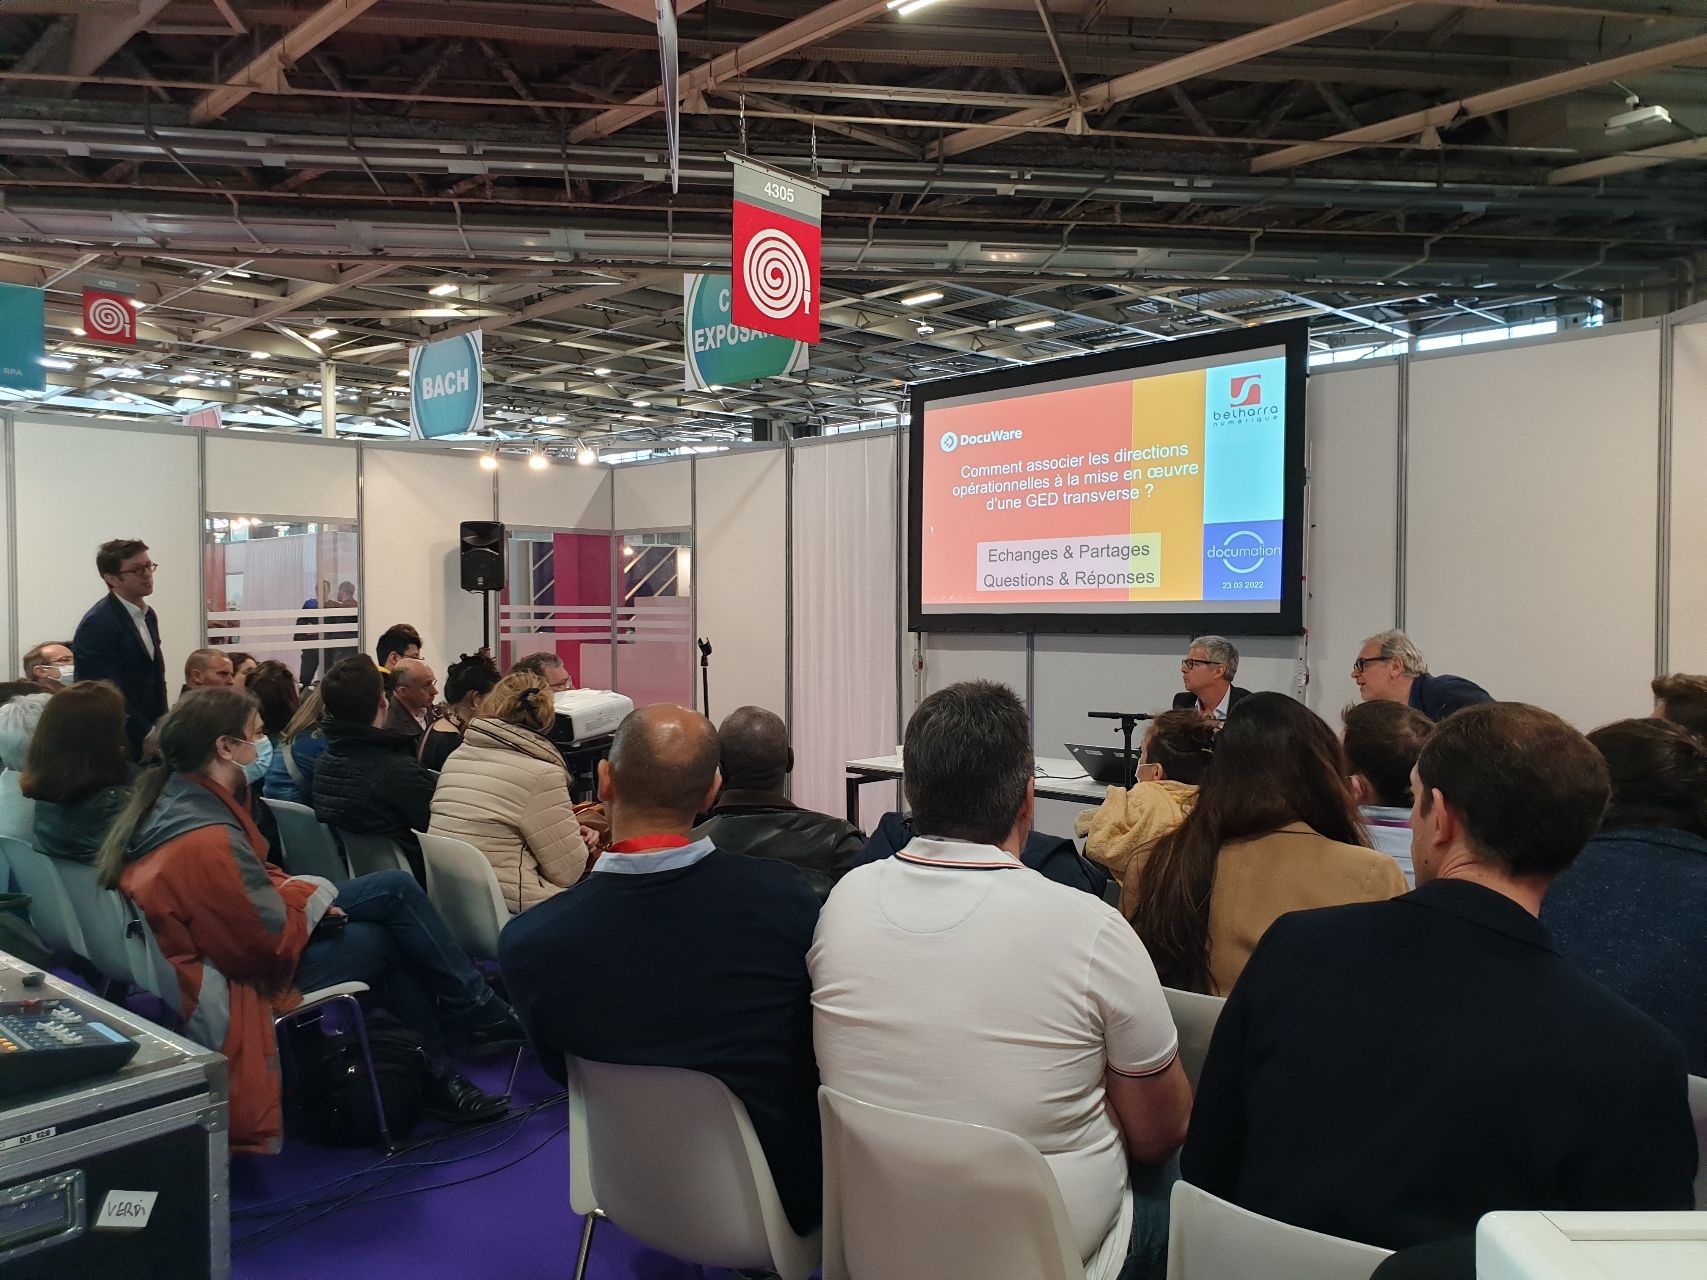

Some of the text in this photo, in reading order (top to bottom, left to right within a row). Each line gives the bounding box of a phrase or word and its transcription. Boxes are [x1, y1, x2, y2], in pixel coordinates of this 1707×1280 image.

[764, 182, 794, 203] 4305
[3, 367, 24, 377] RPA
[422, 367, 469, 400] BACH
[1213, 405, 1278, 421] belharra
[960, 429, 1023, 446] DocuWare
[961, 444, 1189, 478] Comment associer les directions
[952, 463, 1199, 499] opérationnelles à la mise en œuvre
[986, 483, 1154, 511] d'une GED transverse ?
[988, 544, 1150, 564] Echanges & Partages
[1207, 544, 1281, 558] documation
[983, 570, 1155, 589] Questions & Réponses
[1222, 581, 1264, 590] 23 03 2022
